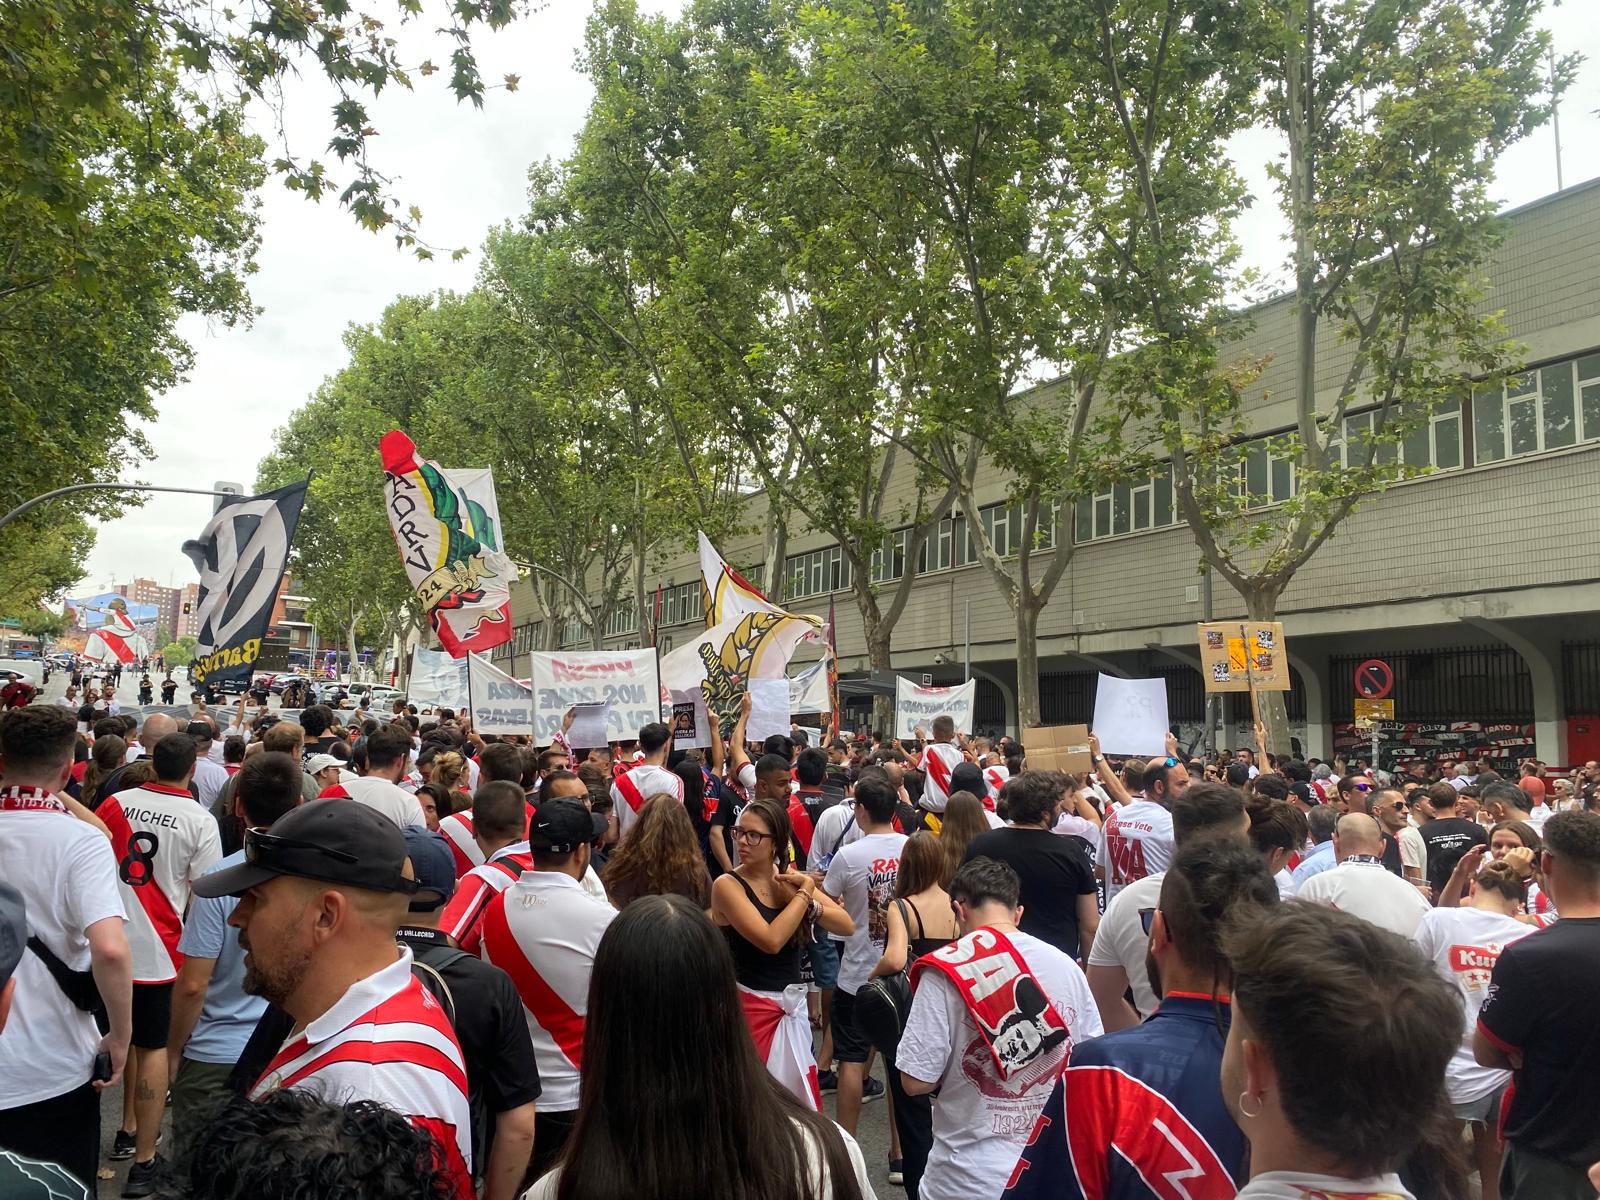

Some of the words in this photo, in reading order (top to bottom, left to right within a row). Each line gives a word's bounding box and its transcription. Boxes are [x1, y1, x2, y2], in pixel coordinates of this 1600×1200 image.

[386, 472, 432, 572] ADRV
[1439, 751, 1460, 760] ADRV
[123, 806, 178, 830] MICHEL
[1135, 821, 1153, 832] Vete
[119, 831, 159, 886] 8
